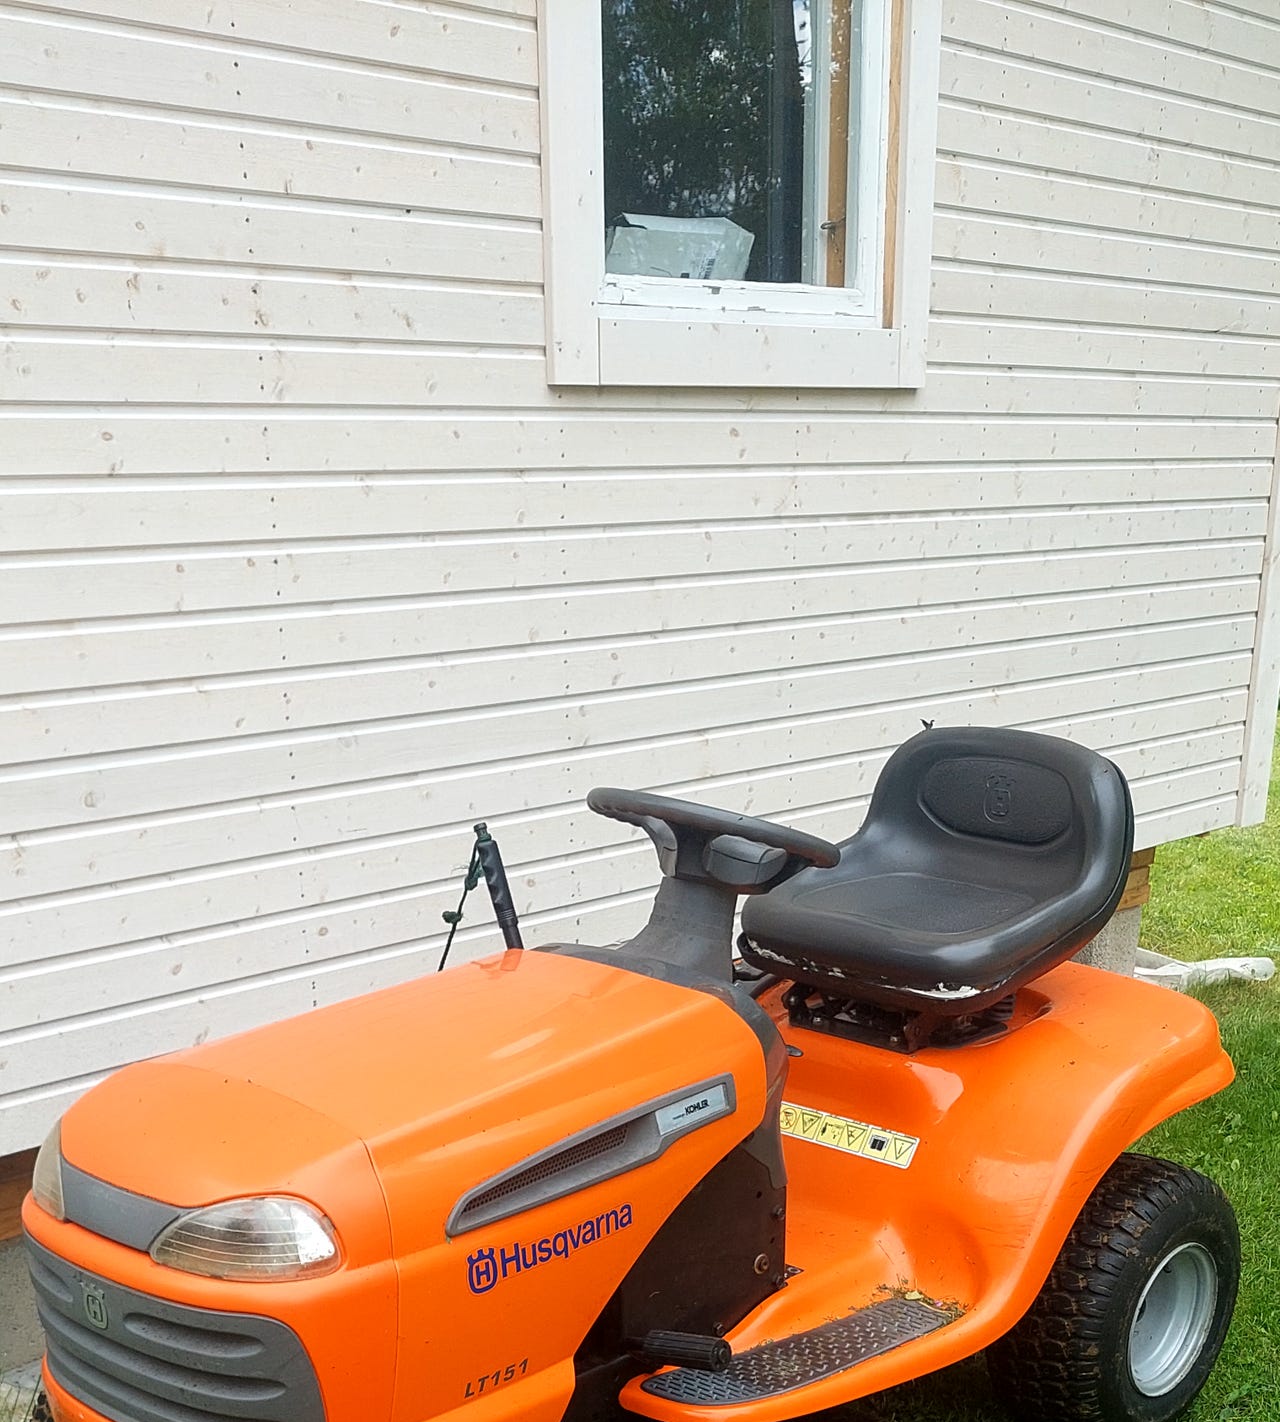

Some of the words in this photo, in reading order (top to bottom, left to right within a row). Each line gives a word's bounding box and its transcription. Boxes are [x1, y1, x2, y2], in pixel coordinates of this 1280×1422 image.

[684, 1099, 710, 1116] KOHLER
[500, 1203, 633, 1278] Husqvarna
[464, 1357, 529, 1399] LT151
